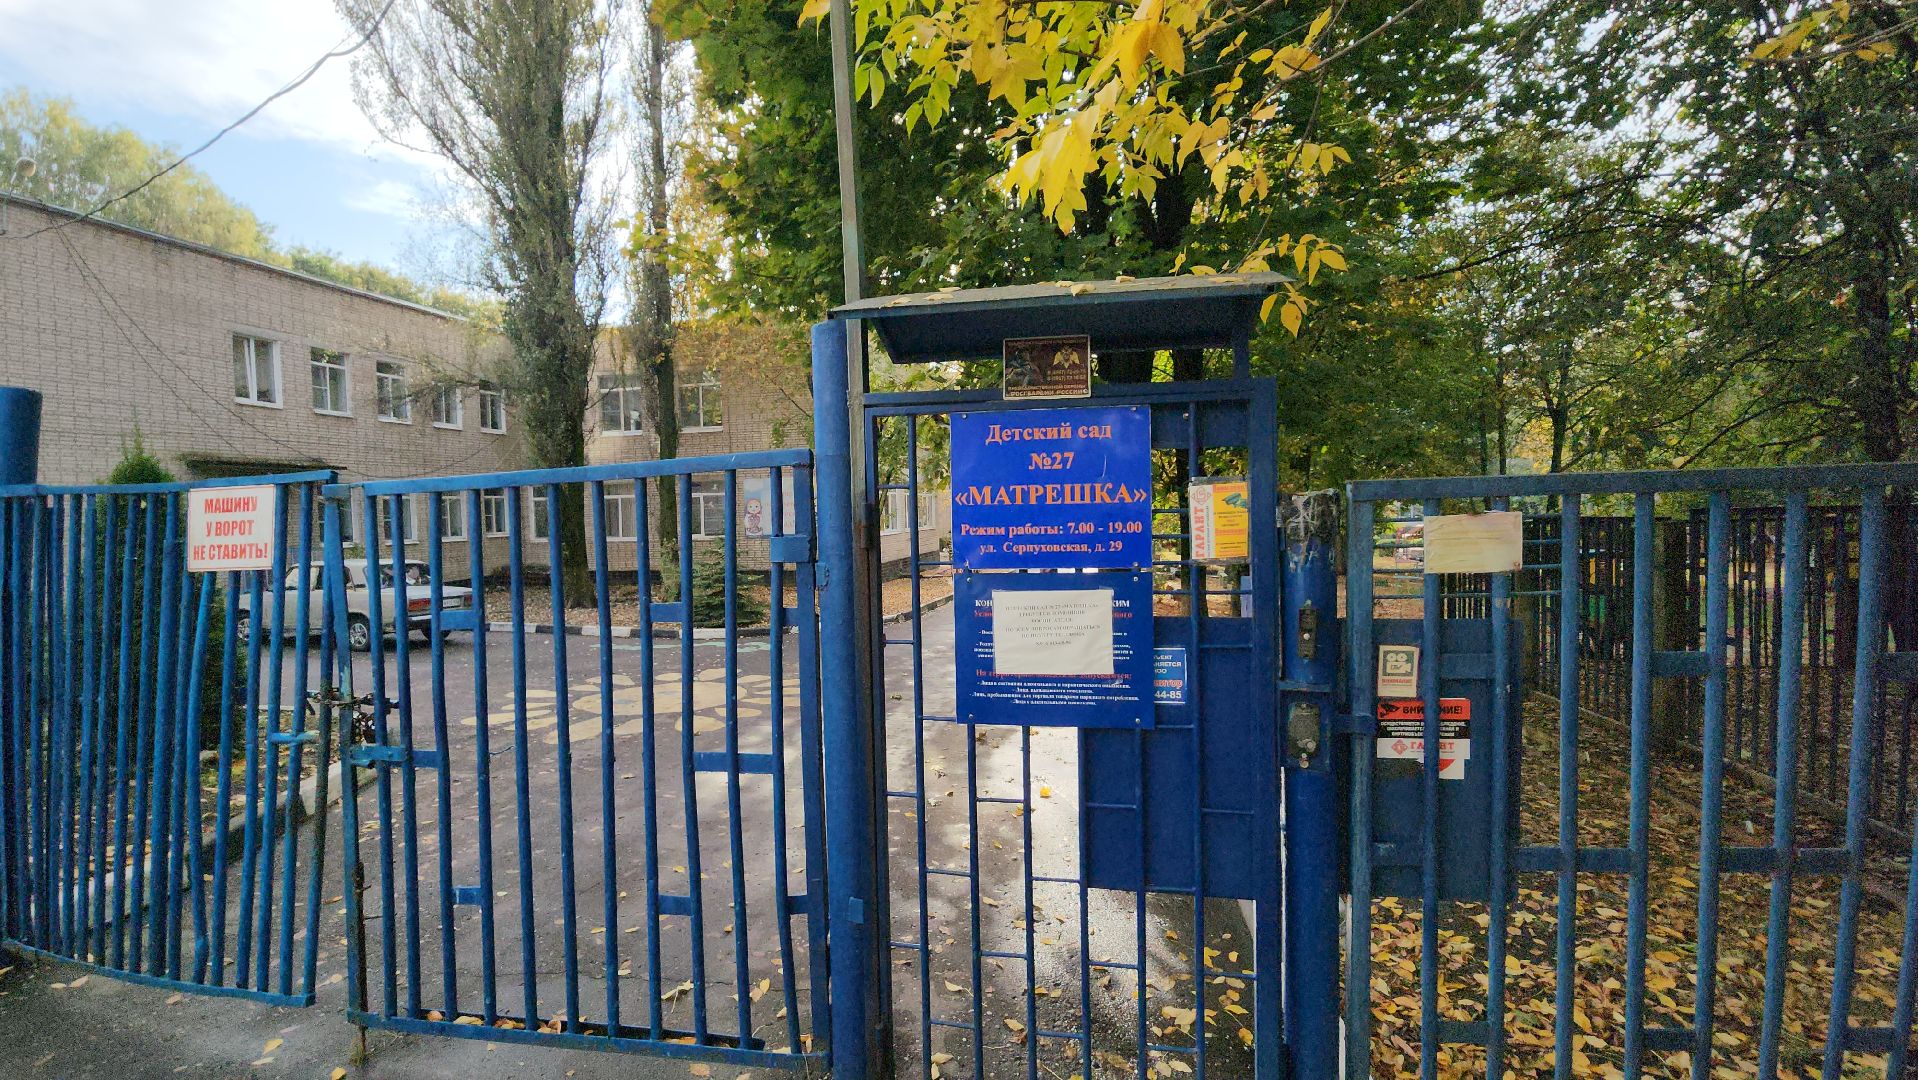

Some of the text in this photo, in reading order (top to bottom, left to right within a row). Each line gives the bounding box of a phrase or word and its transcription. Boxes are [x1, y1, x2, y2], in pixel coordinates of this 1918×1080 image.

[985, 422, 1112, 446] Детский сад
[1028, 452, 1075, 470] №27
[955, 483, 1147, 506] «МАТРЕШКА»
[204, 496, 258, 514] МАШИНУ
[206, 520, 254, 537] У ВОРОТ
[960, 523, 1005, 536] Режим
[1008, 522, 1064, 538] работы:
[1067, 522, 1094, 535] 7.00
[1108, 521, 1142, 534] 19.00
[1193, 506, 1205, 557] ГАРАНТ
[193, 543, 268, 561] НЕ СТАВИТЬ!
[979, 540, 1123, 555] ул. Серпуховская, д. 29
[1403, 705, 1463, 715] ВНИНИЕ!
[1410, 742, 1455, 750] ГАНТ
